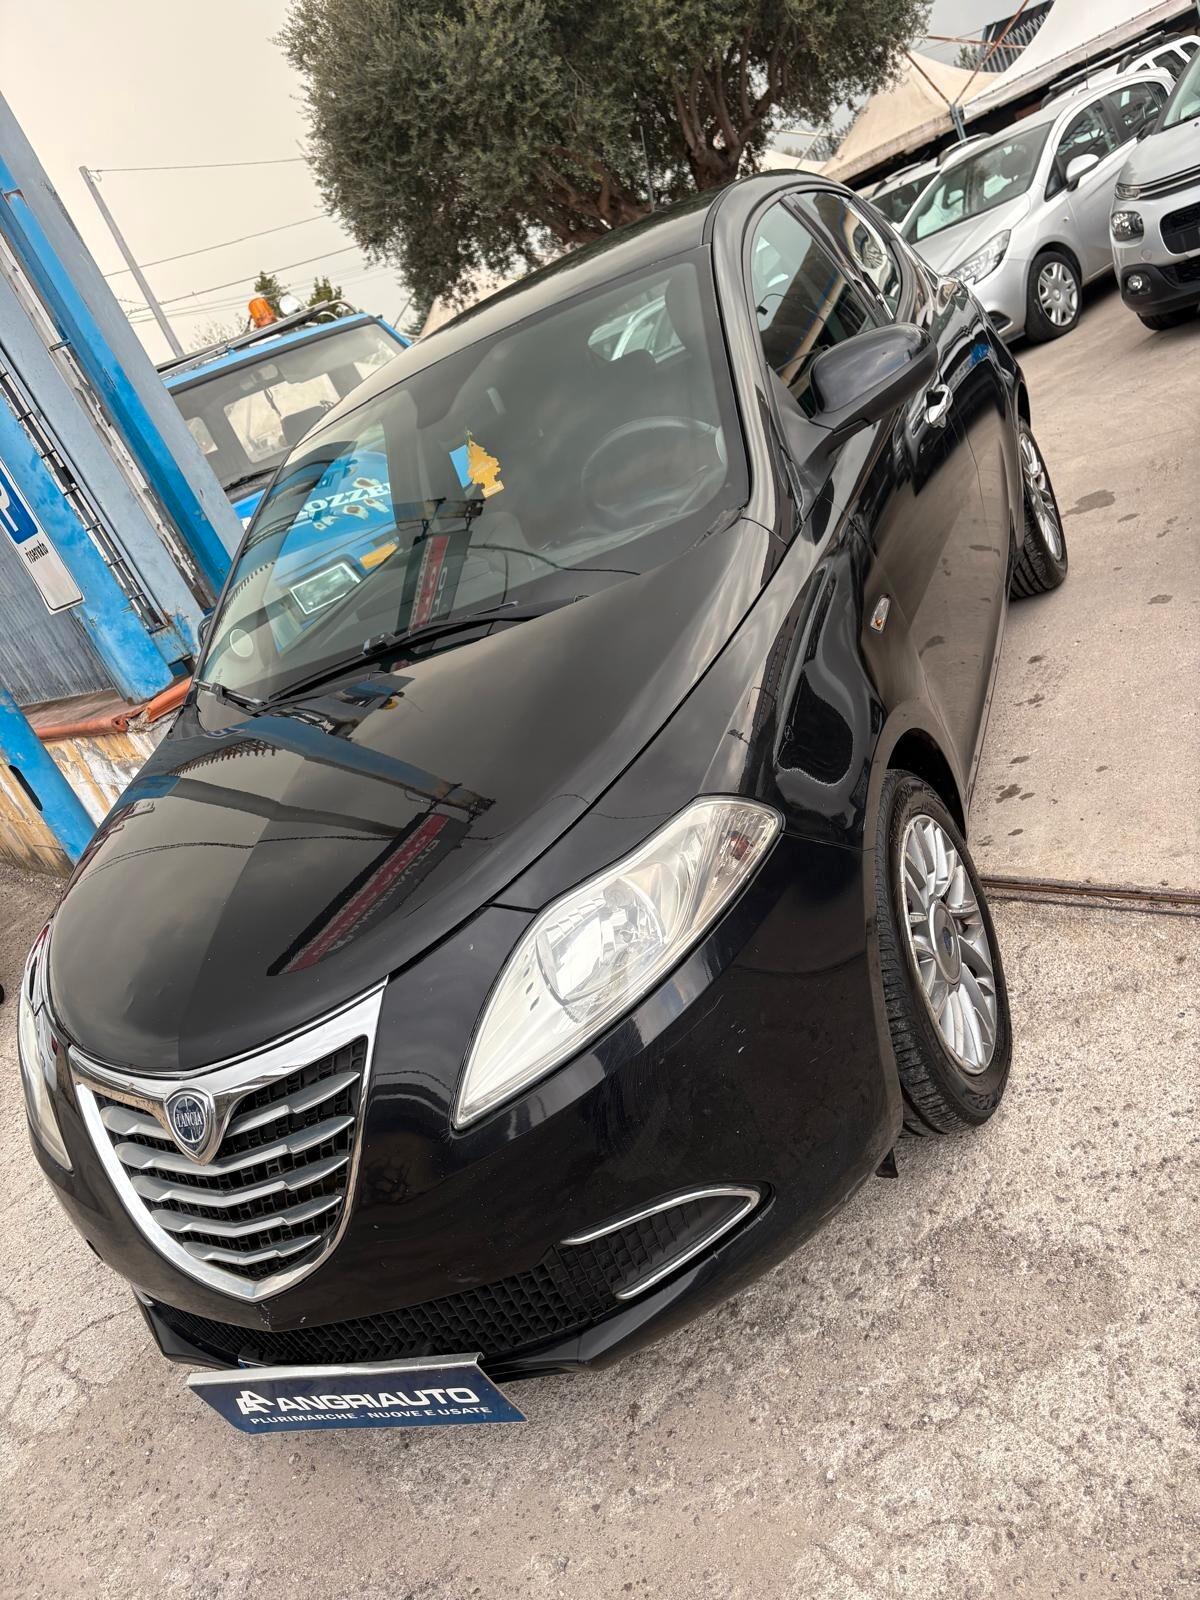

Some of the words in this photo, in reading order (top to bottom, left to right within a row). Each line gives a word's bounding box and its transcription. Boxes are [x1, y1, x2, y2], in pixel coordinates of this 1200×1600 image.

[176, 1111, 203, 1128] LANCIA
[276, 1387, 480, 1412] ANGRIAUTO
[249, 1412, 358, 1425] PLURIMARCHE
[367, 1409, 423, 1419] NUOVE
[440, 1406, 493, 1416] USATE
